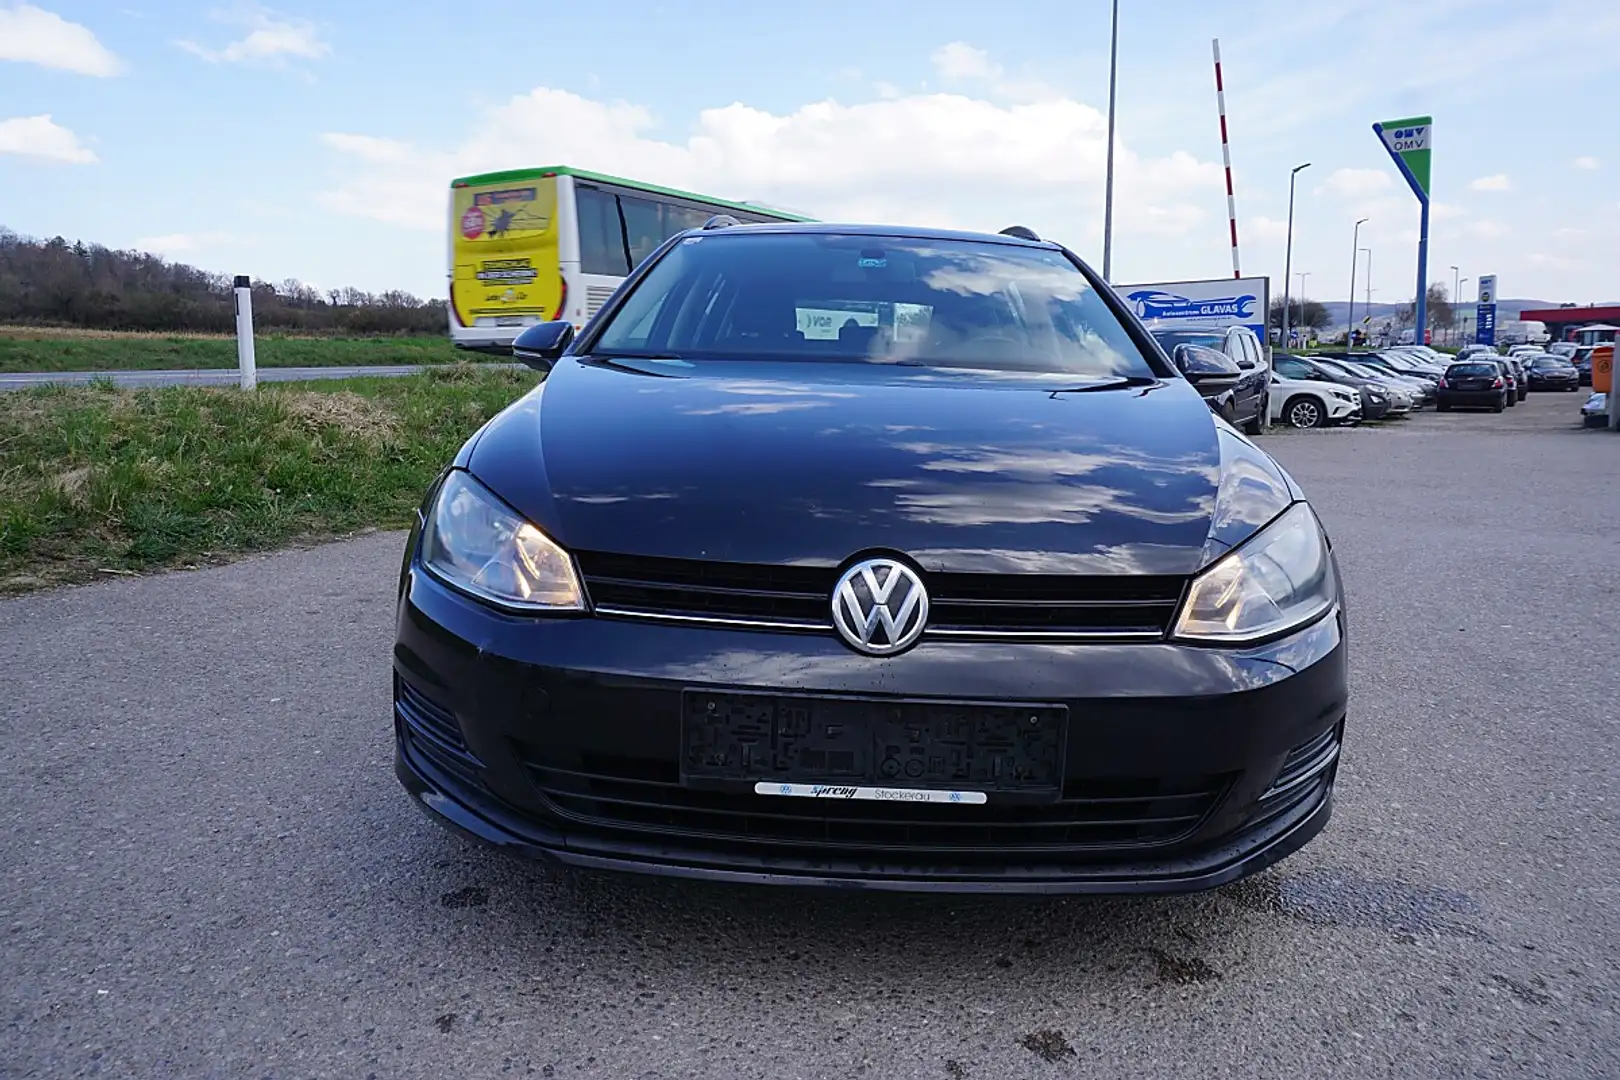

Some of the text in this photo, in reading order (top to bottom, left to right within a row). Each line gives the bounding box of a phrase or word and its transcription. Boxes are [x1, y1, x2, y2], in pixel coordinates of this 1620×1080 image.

[1393, 140, 1424, 151] OMV
[1200, 303, 1238, 315] GLAVAS
[835, 561, 925, 651] VW
[874, 788, 931, 802] Stockerau
